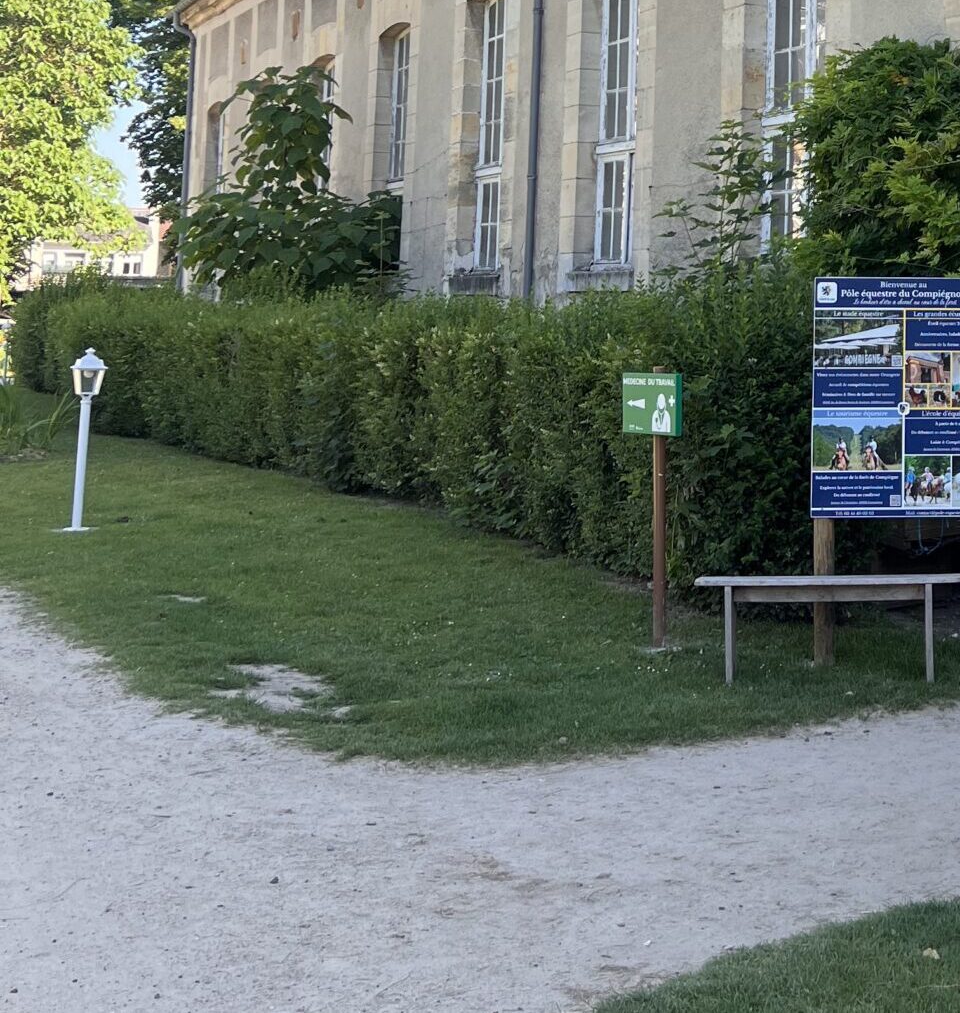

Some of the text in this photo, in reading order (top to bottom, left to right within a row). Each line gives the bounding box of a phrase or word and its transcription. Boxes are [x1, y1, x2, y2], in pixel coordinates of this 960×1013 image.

[841, 289, 860, 298] Pôle
[861, 289, 897, 300] équestre
[898, 289, 910, 298] du
[858, 311, 884, 319] équestre
[655, 378, 676, 386] TRAVAIL
